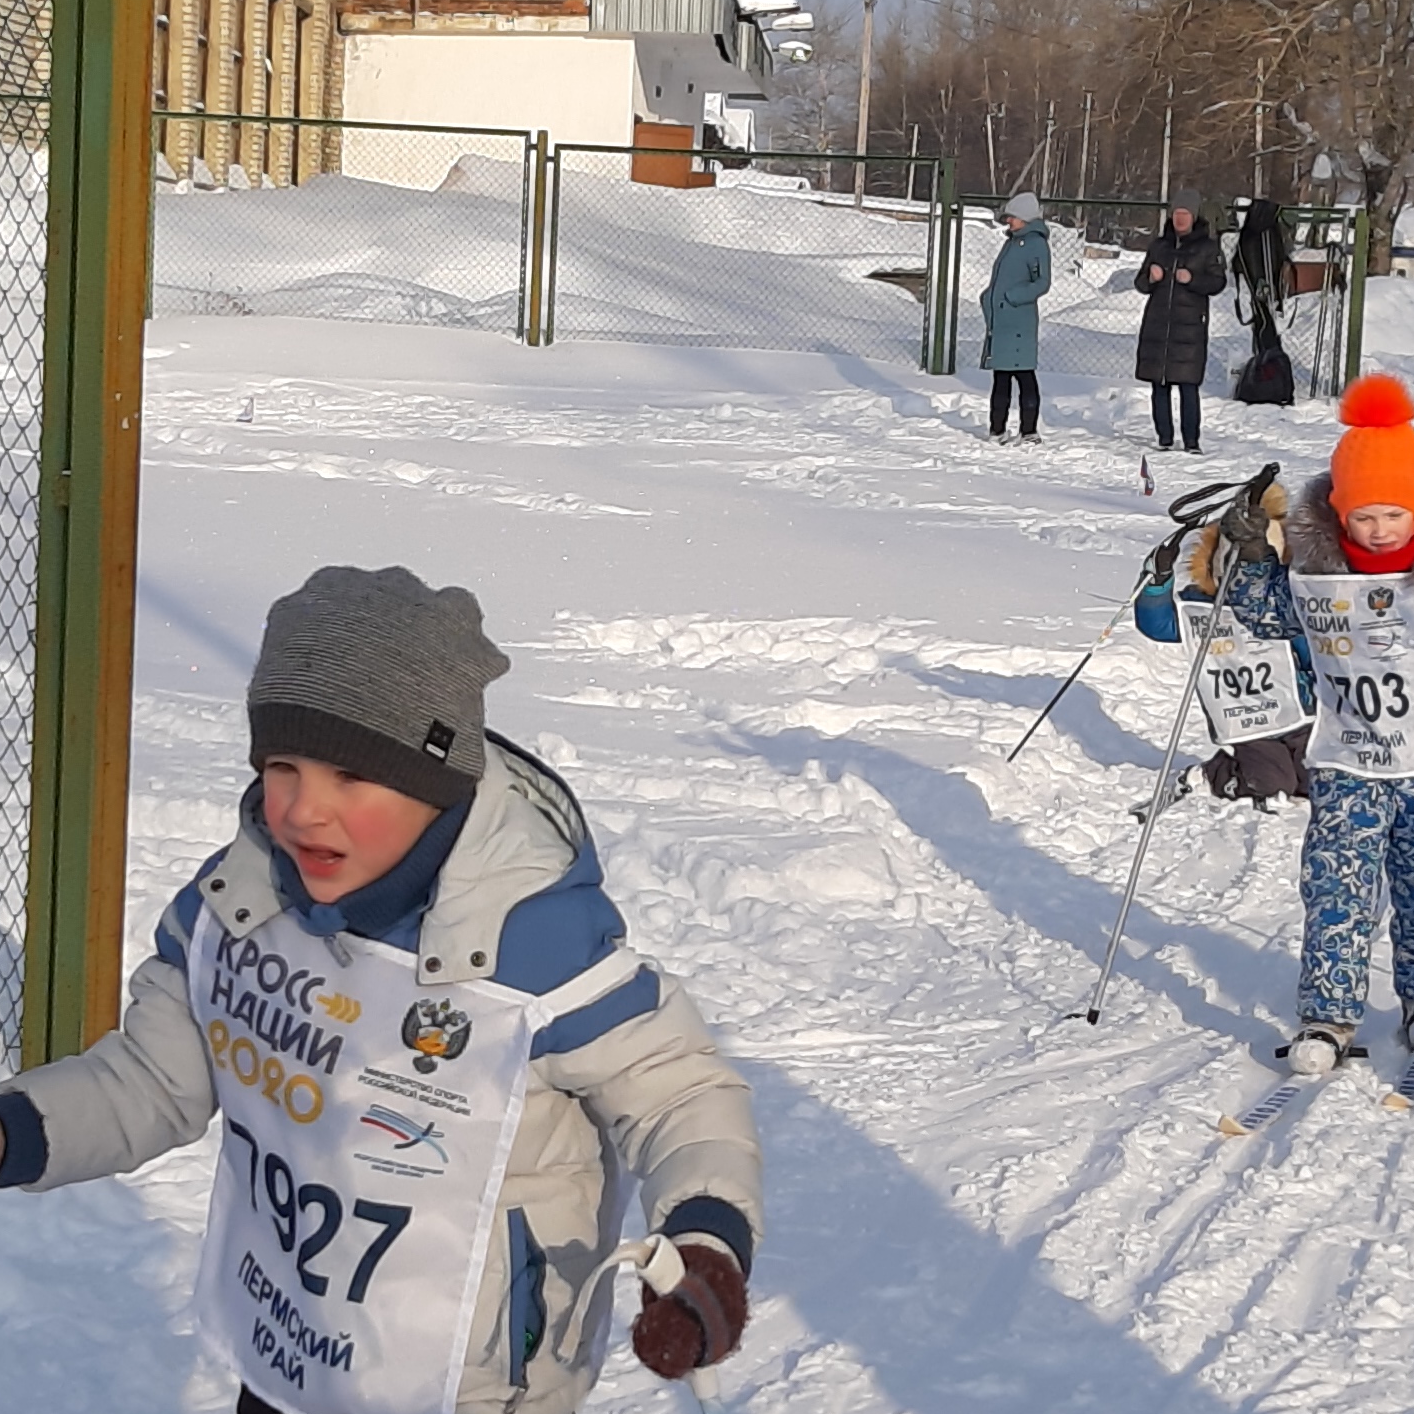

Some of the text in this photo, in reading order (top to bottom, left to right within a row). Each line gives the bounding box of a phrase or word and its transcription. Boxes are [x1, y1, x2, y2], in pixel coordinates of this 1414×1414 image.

[1298, 597, 1332, 614] РОСС
[1307, 616, 1351, 634] АЦИИ
[1207, 662, 1274, 699] 7922
[217, 931, 327, 1013] КРОСС
[211, 971, 344, 1075] НАЦИИ
[208, 1018, 324, 1125] 2020
[229, 1118, 413, 1304] 7927
[238, 1249, 356, 1374] ПЕРМСКИЙ
[252, 1322, 306, 1391] КРАЙ
